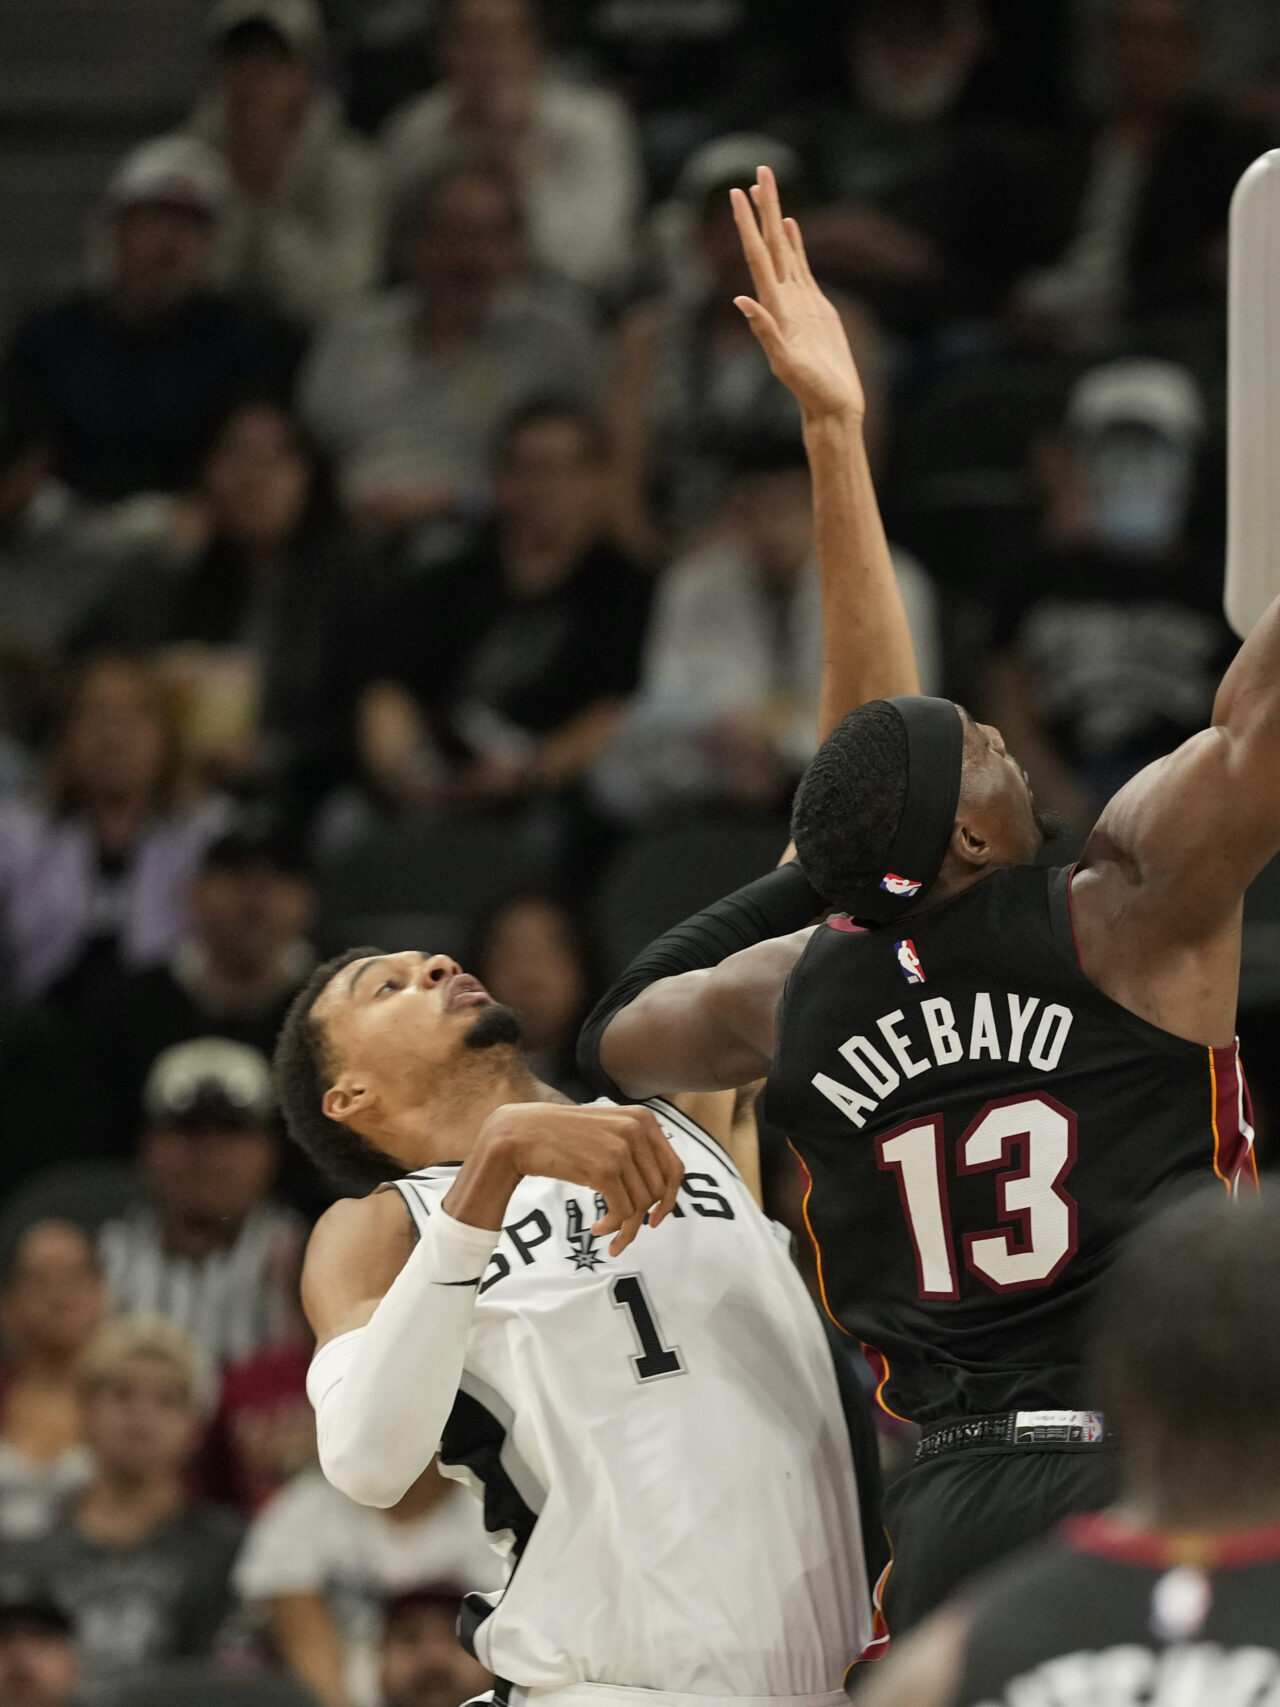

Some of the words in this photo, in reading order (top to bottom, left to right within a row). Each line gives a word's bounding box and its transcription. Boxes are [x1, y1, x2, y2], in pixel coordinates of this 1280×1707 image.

[811, 992, 1073, 1129] ADEBAYO
[873, 1089, 1078, 1301] 13
[608, 1271, 689, 1385] 1
